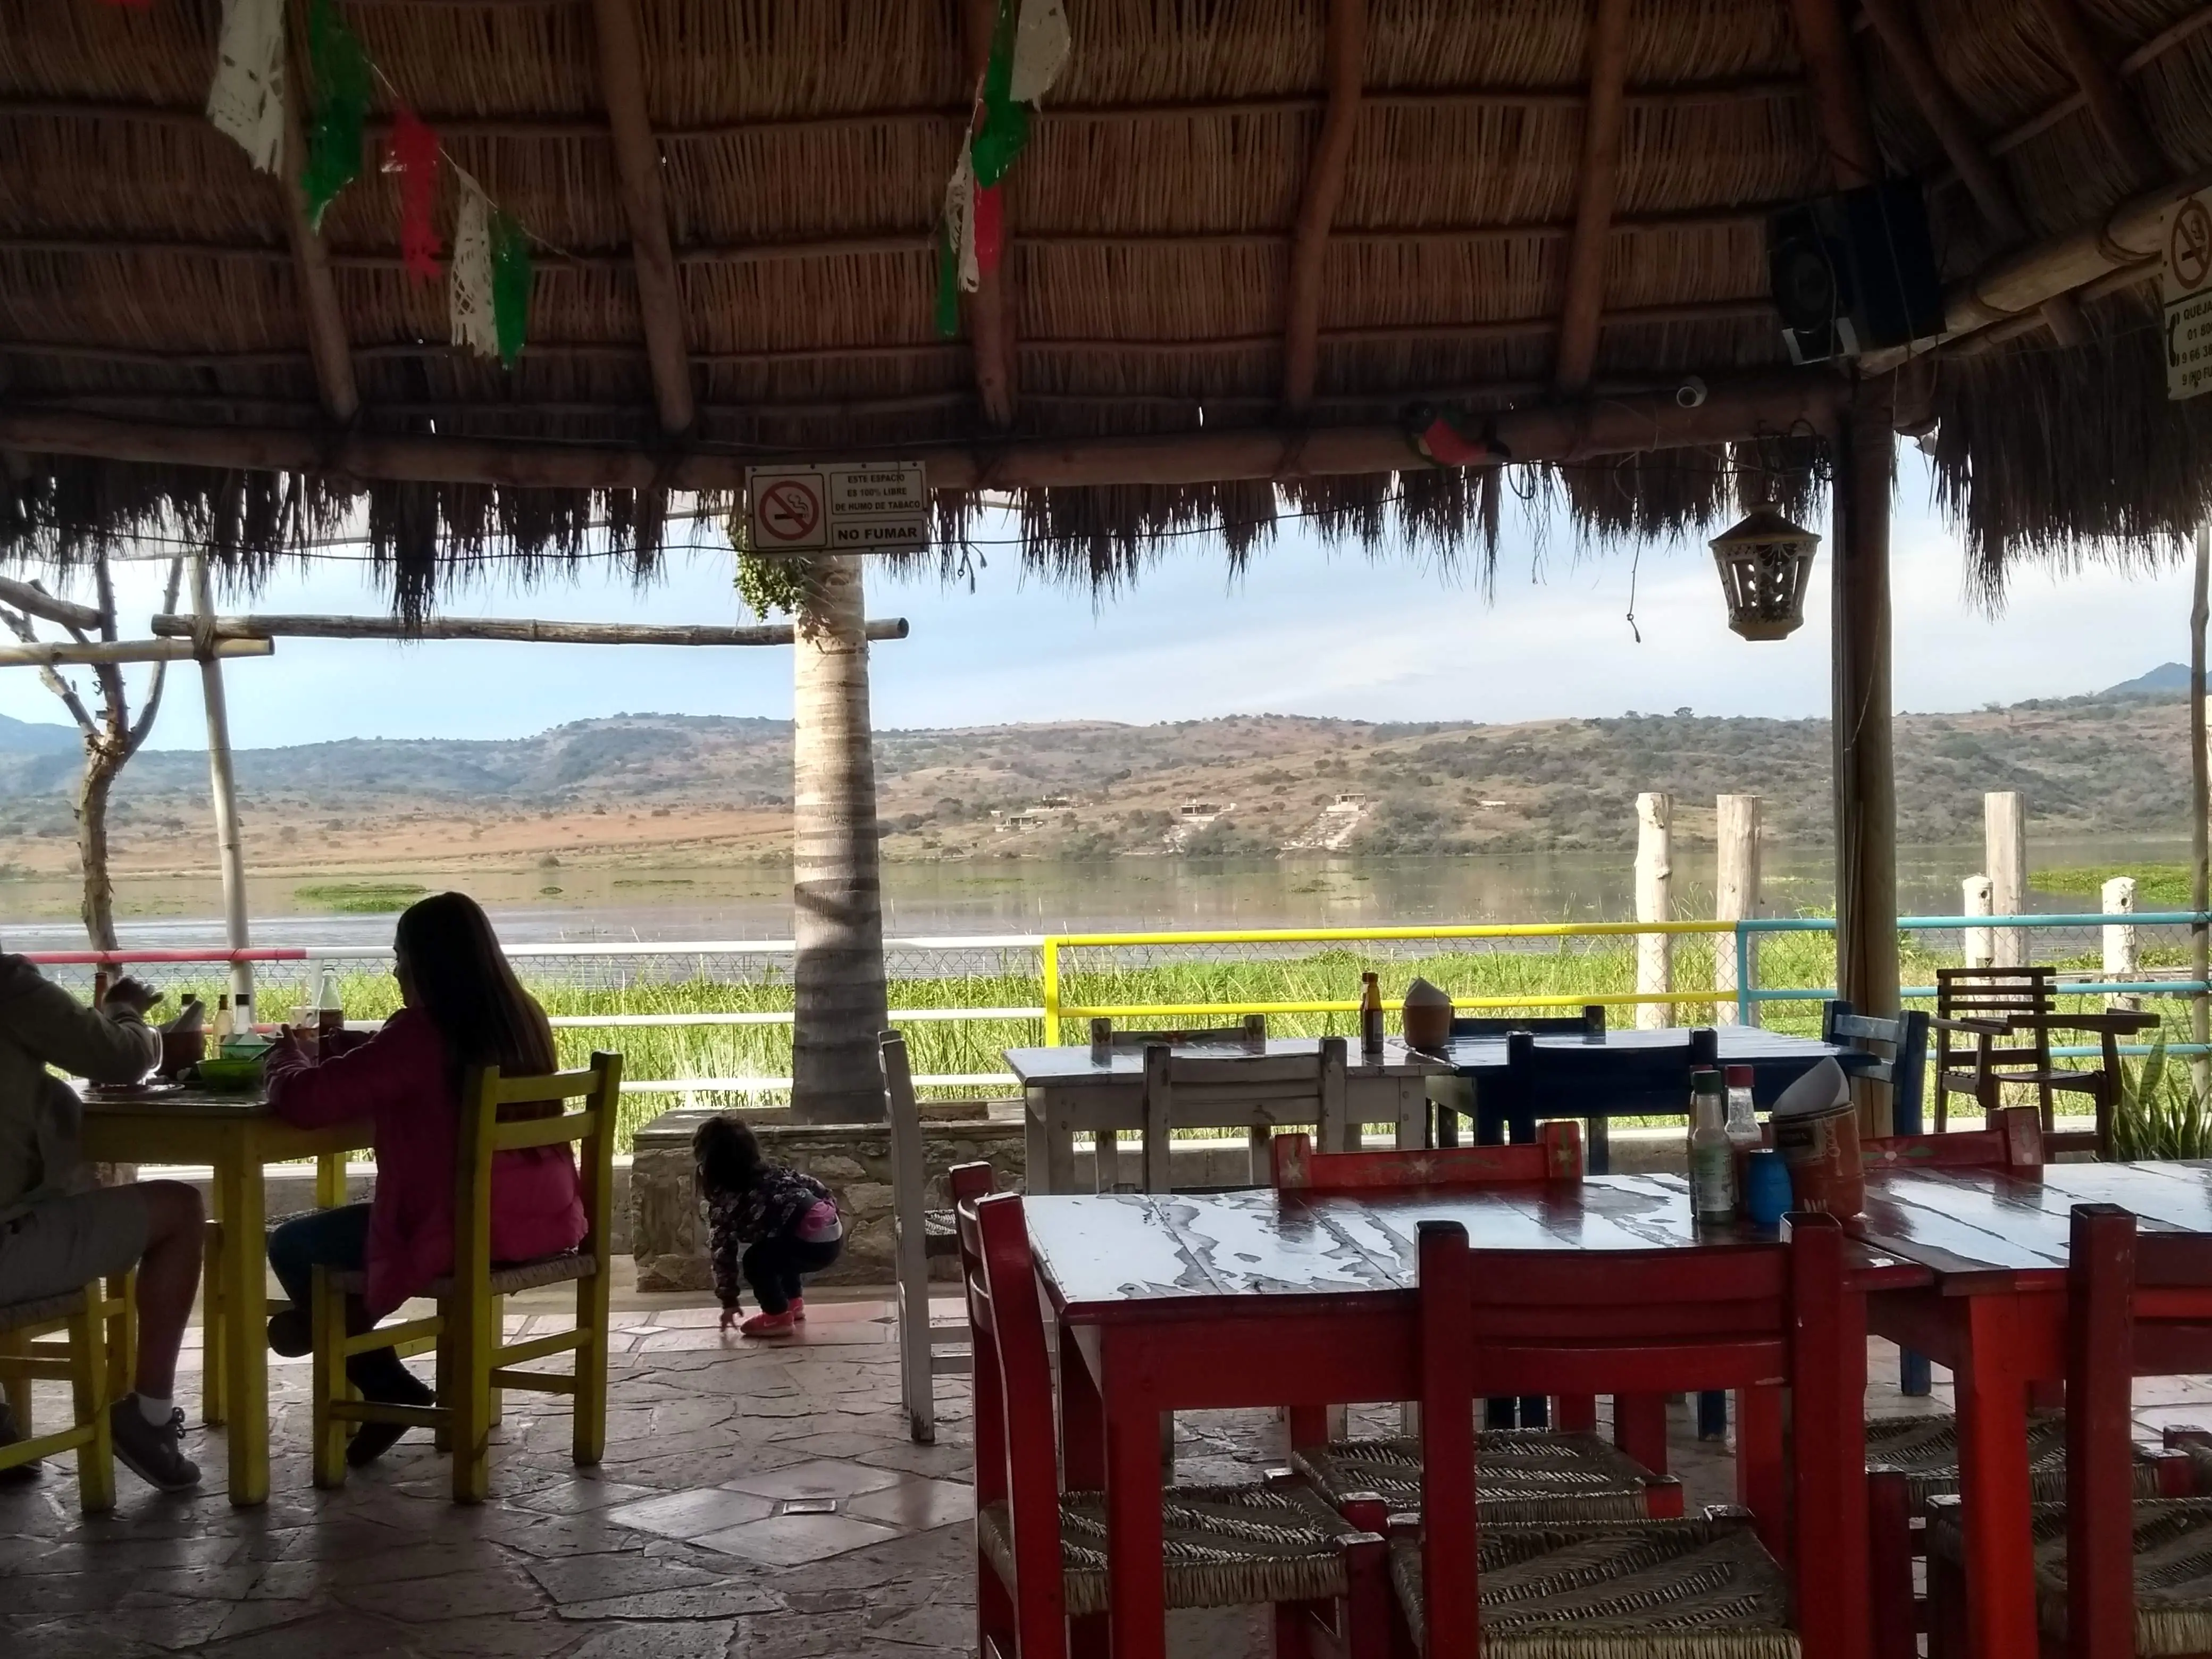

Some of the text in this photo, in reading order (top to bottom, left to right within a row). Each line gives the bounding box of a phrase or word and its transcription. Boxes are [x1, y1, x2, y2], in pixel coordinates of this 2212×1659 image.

[2188, 322, 2212, 340] 01 80
[2182, 352, 2186, 363] 9
[2190, 347, 2200, 362] 66
[2182, 374, 2186, 386] 9
[848, 474, 905, 483] ESTE ESPACIO
[860, 488, 881, 497] 100%
[883, 487, 907, 496] LIBRE
[849, 502, 873, 510] HUMO
[888, 500, 920, 509] TABACO
[838, 527, 917, 540] NO FUMAR
